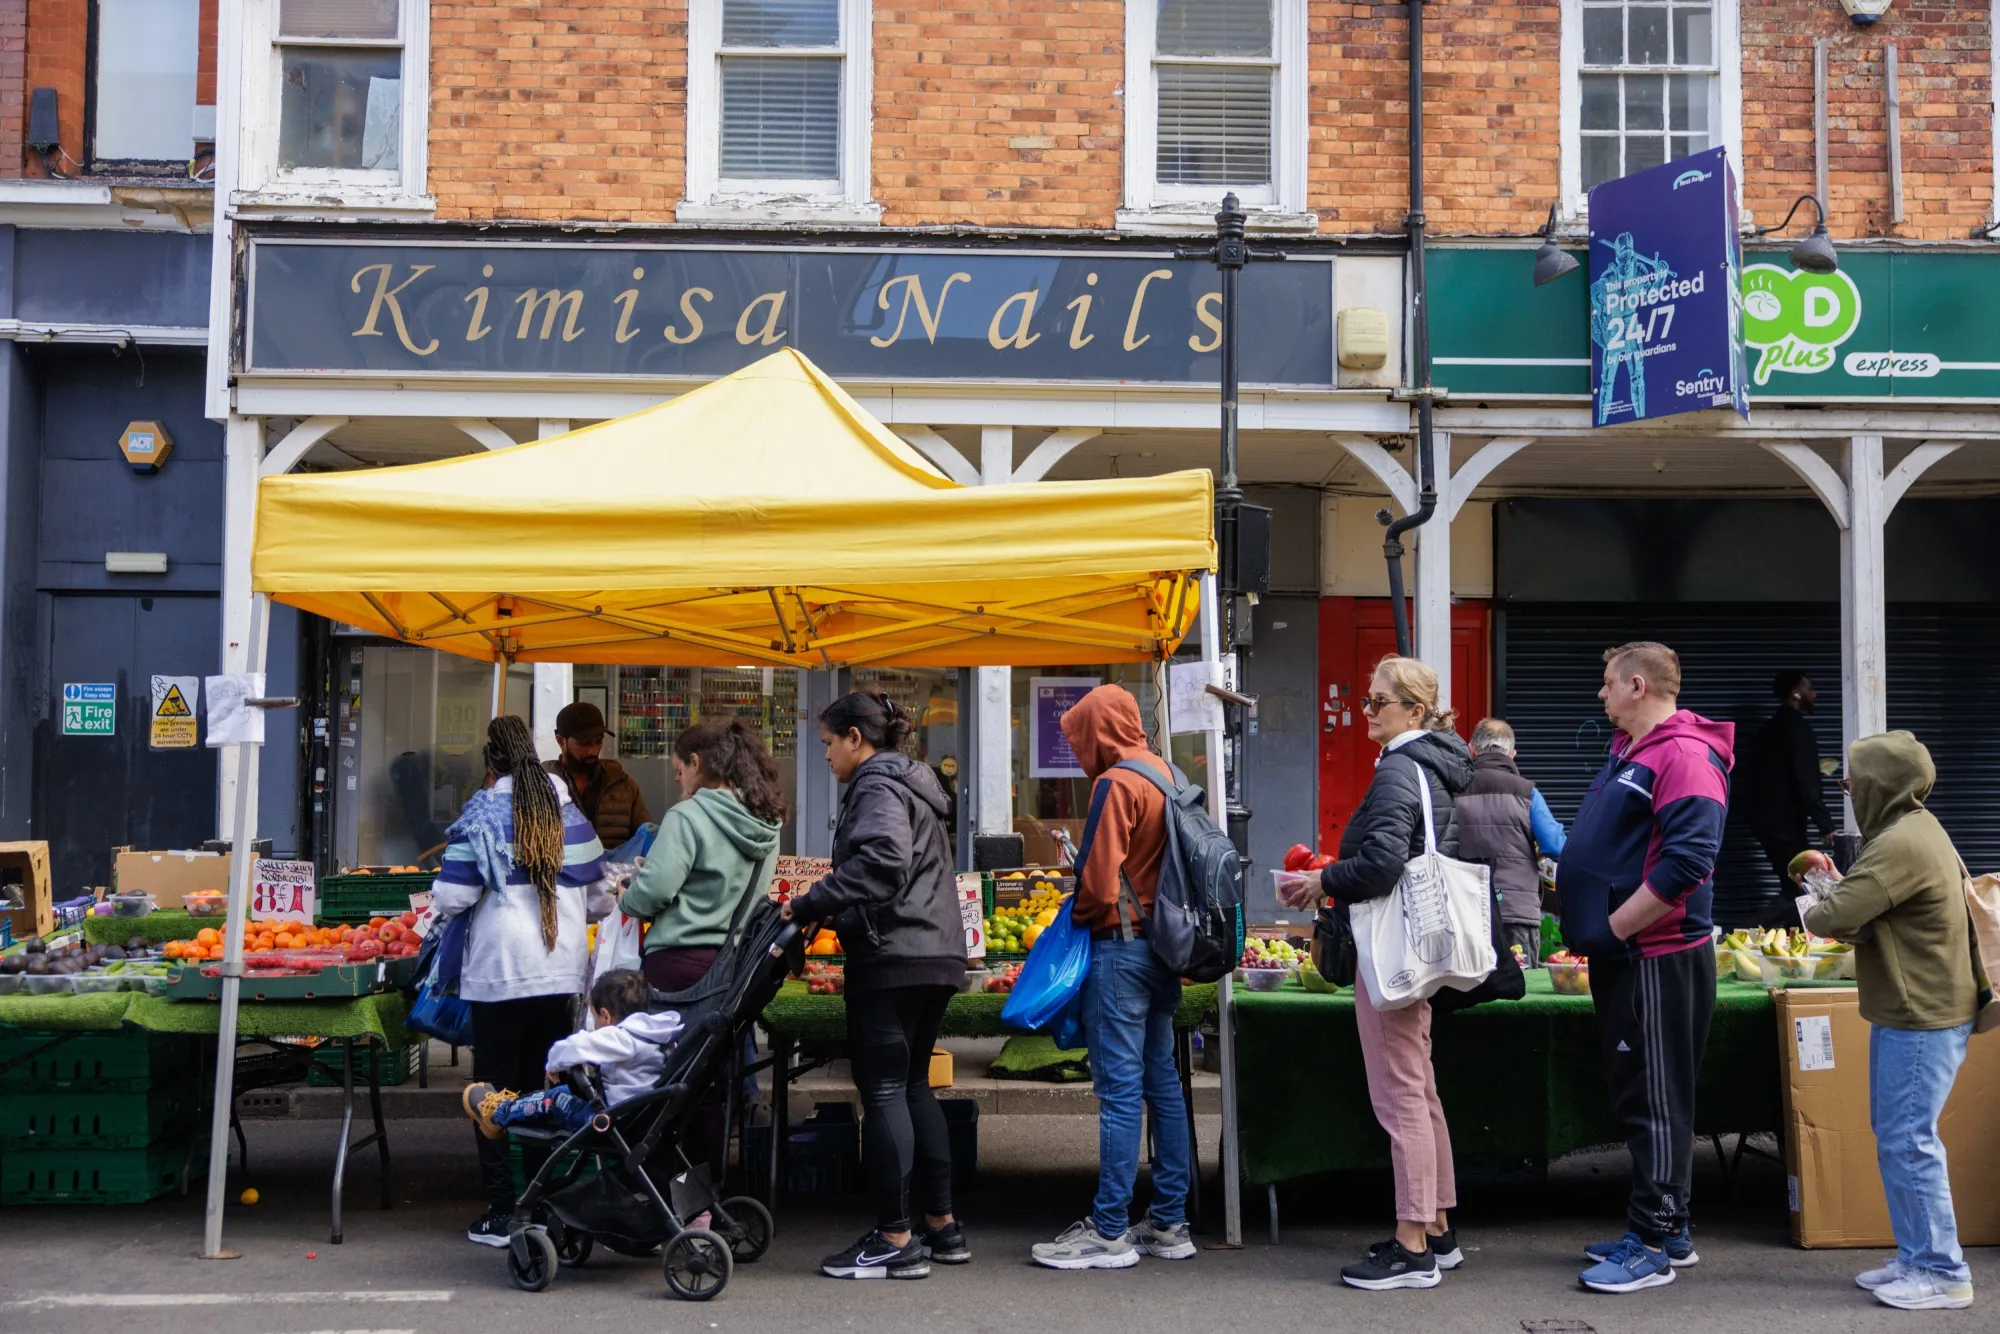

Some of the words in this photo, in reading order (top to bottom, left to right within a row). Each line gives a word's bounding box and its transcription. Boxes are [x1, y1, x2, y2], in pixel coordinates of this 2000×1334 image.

[1606, 281, 1622, 293] This
[1624, 272, 1658, 289] property
[1660, 269, 1668, 278] is
[1606, 270, 1705, 316] Protected
[351, 263, 788, 356] Kimisa
[870, 268, 1222, 353] Nails
[1607, 303, 1675, 351] 24/7
[1618, 352, 1633, 362] our
[1634, 342, 1677, 359] guardians
[1759, 340, 1831, 381] plus
[1856, 355, 1929, 378] express
[1675, 376, 1725, 397] Sentry
[85, 705, 112, 718] Fire
[84, 717, 110, 730] exit
